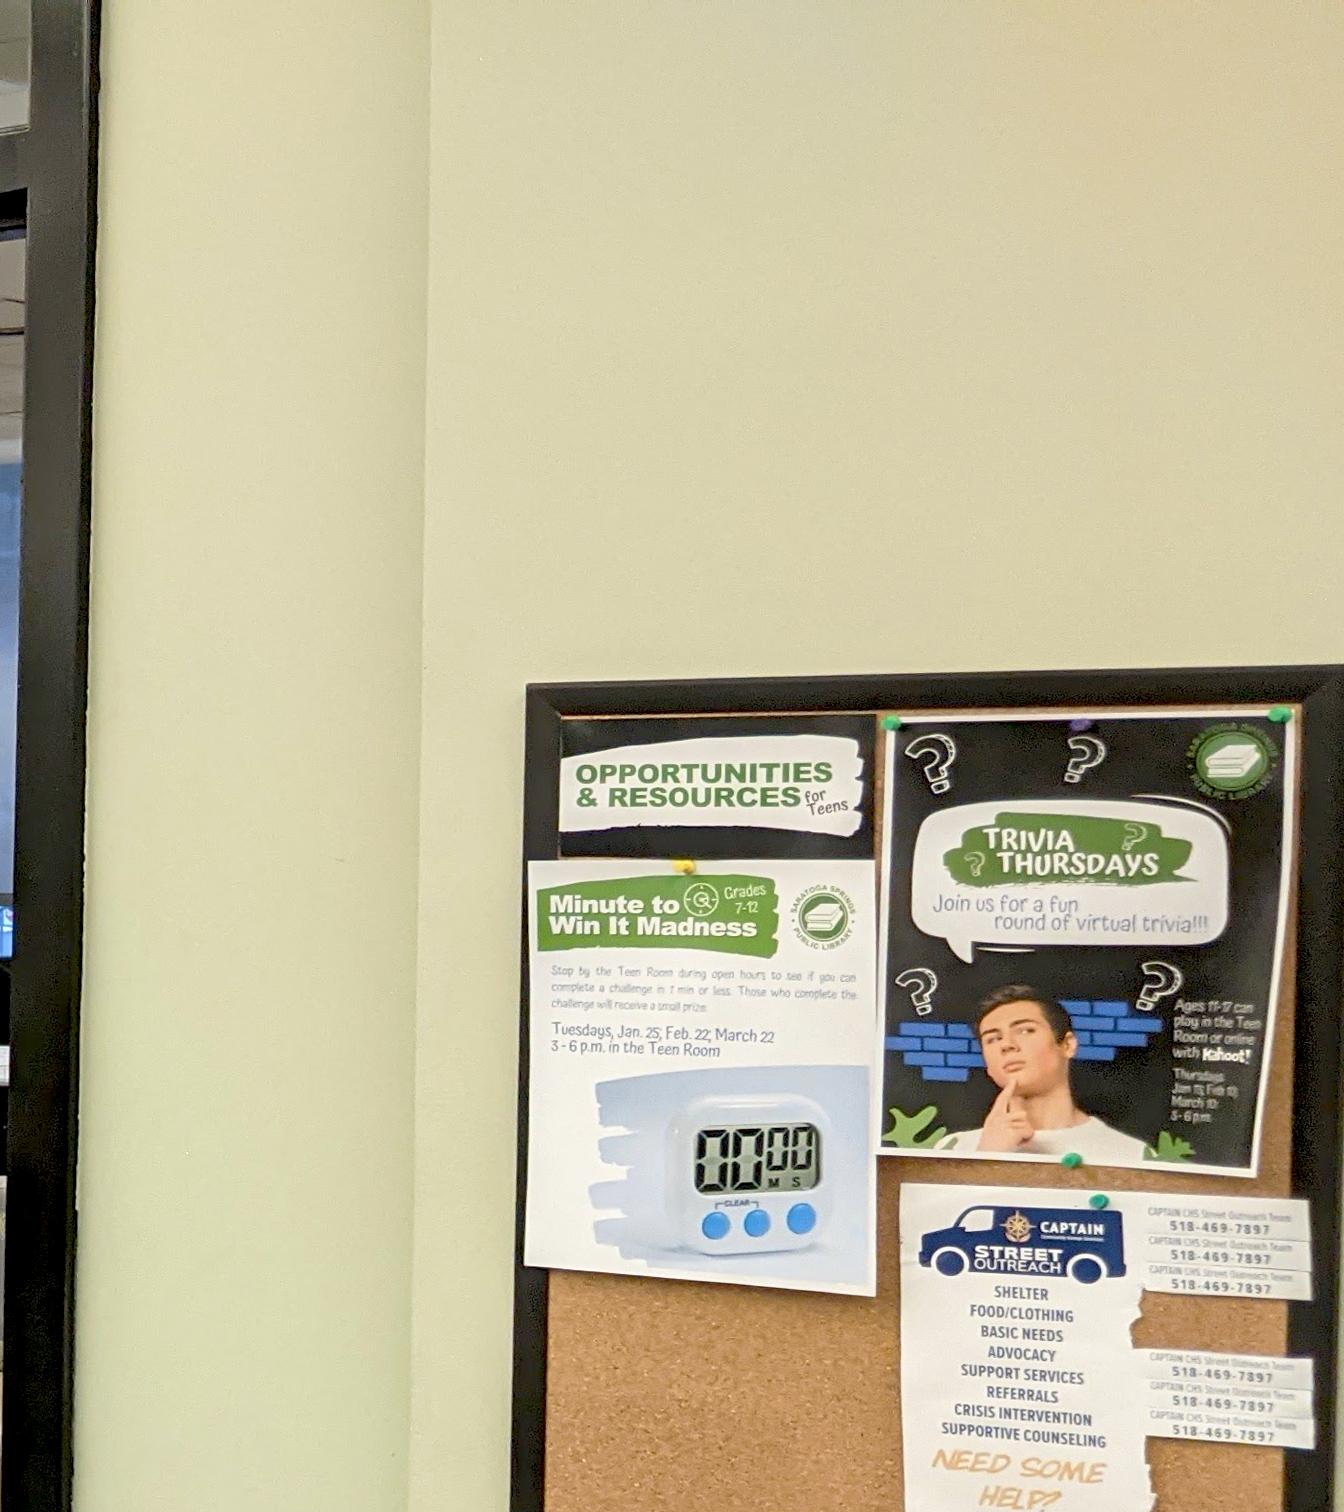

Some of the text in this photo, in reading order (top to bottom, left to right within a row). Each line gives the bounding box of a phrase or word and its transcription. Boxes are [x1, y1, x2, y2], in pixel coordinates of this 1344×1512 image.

[576, 762, 832, 784] OPPORTUNITIES
[576, 786, 826, 807] & RESOURCES for
[808, 800, 848, 816] Teens
[983, 828, 1075, 852] TRIVIA
[996, 851, 1160, 877] THURSDAYS
[725, 885, 766, 899] Grades
[791, 885, 856, 914] SARATOGA SPRINGS
[550, 895, 680, 914] Minute to
[736, 902, 758, 914] 7-12
[933, 894, 1078, 914] Join us for a fun
[549, 916, 757, 937] Win It Madness
[994, 913, 1209, 934] round of virtual trivia!!!
[794, 927, 852, 950] PUBLIC LIBRARY
[552, 1022, 614, 1039] Tuesdays,
[618, 1025, 642, 1038] Jan.
[666, 1026, 692, 1040] Feb.
[715, 1028, 757, 1042] March
[761, 1032, 774, 1043] 22
[609, 1041, 619, 1053] in
[624, 1041, 644, 1054] the
[649, 1042, 679, 1055] Teen
[684, 1043, 720, 1057] Room
[768, 1177, 800, 1188] M S
[1040, 1221, 1105, 1235] CAPTAIN
[1170, 1221, 1270, 1235] 518-469-7897
[975, 1245, 1063, 1261] STREET
[1171, 1250, 1271, 1265] 518-469-7897
[974, 1258, 1061, 1273] OUTREACH
[995, 1285, 1048, 1300] SHELTER
[1171, 1279, 1271, 1294] 518-469-7897
[970, 1304, 1074, 1322] FOOD/CLOTHING
[981, 1325, 1063, 1342] BASIC NEEDS
[988, 1346, 1056, 1361] ADVOCACY
[961, 1364, 1084, 1384] SUPPORT SERVICES
[1172, 1366, 1272, 1383] 518-469-7897
[987, 1386, 1058, 1403] REFERRALS
[1173, 1395, 1274, 1412] 518-469-7897
[954, 1403, 1092, 1426] CRISIS INTERVENTION
[942, 1422, 1106, 1448] SUPPORTIVE COUNSELING
[1173, 1425, 1274, 1441] 518-469-7897
[932, 1449, 1107, 1483] NEED SOME
[979, 1485, 1061, 1512] HELP?
